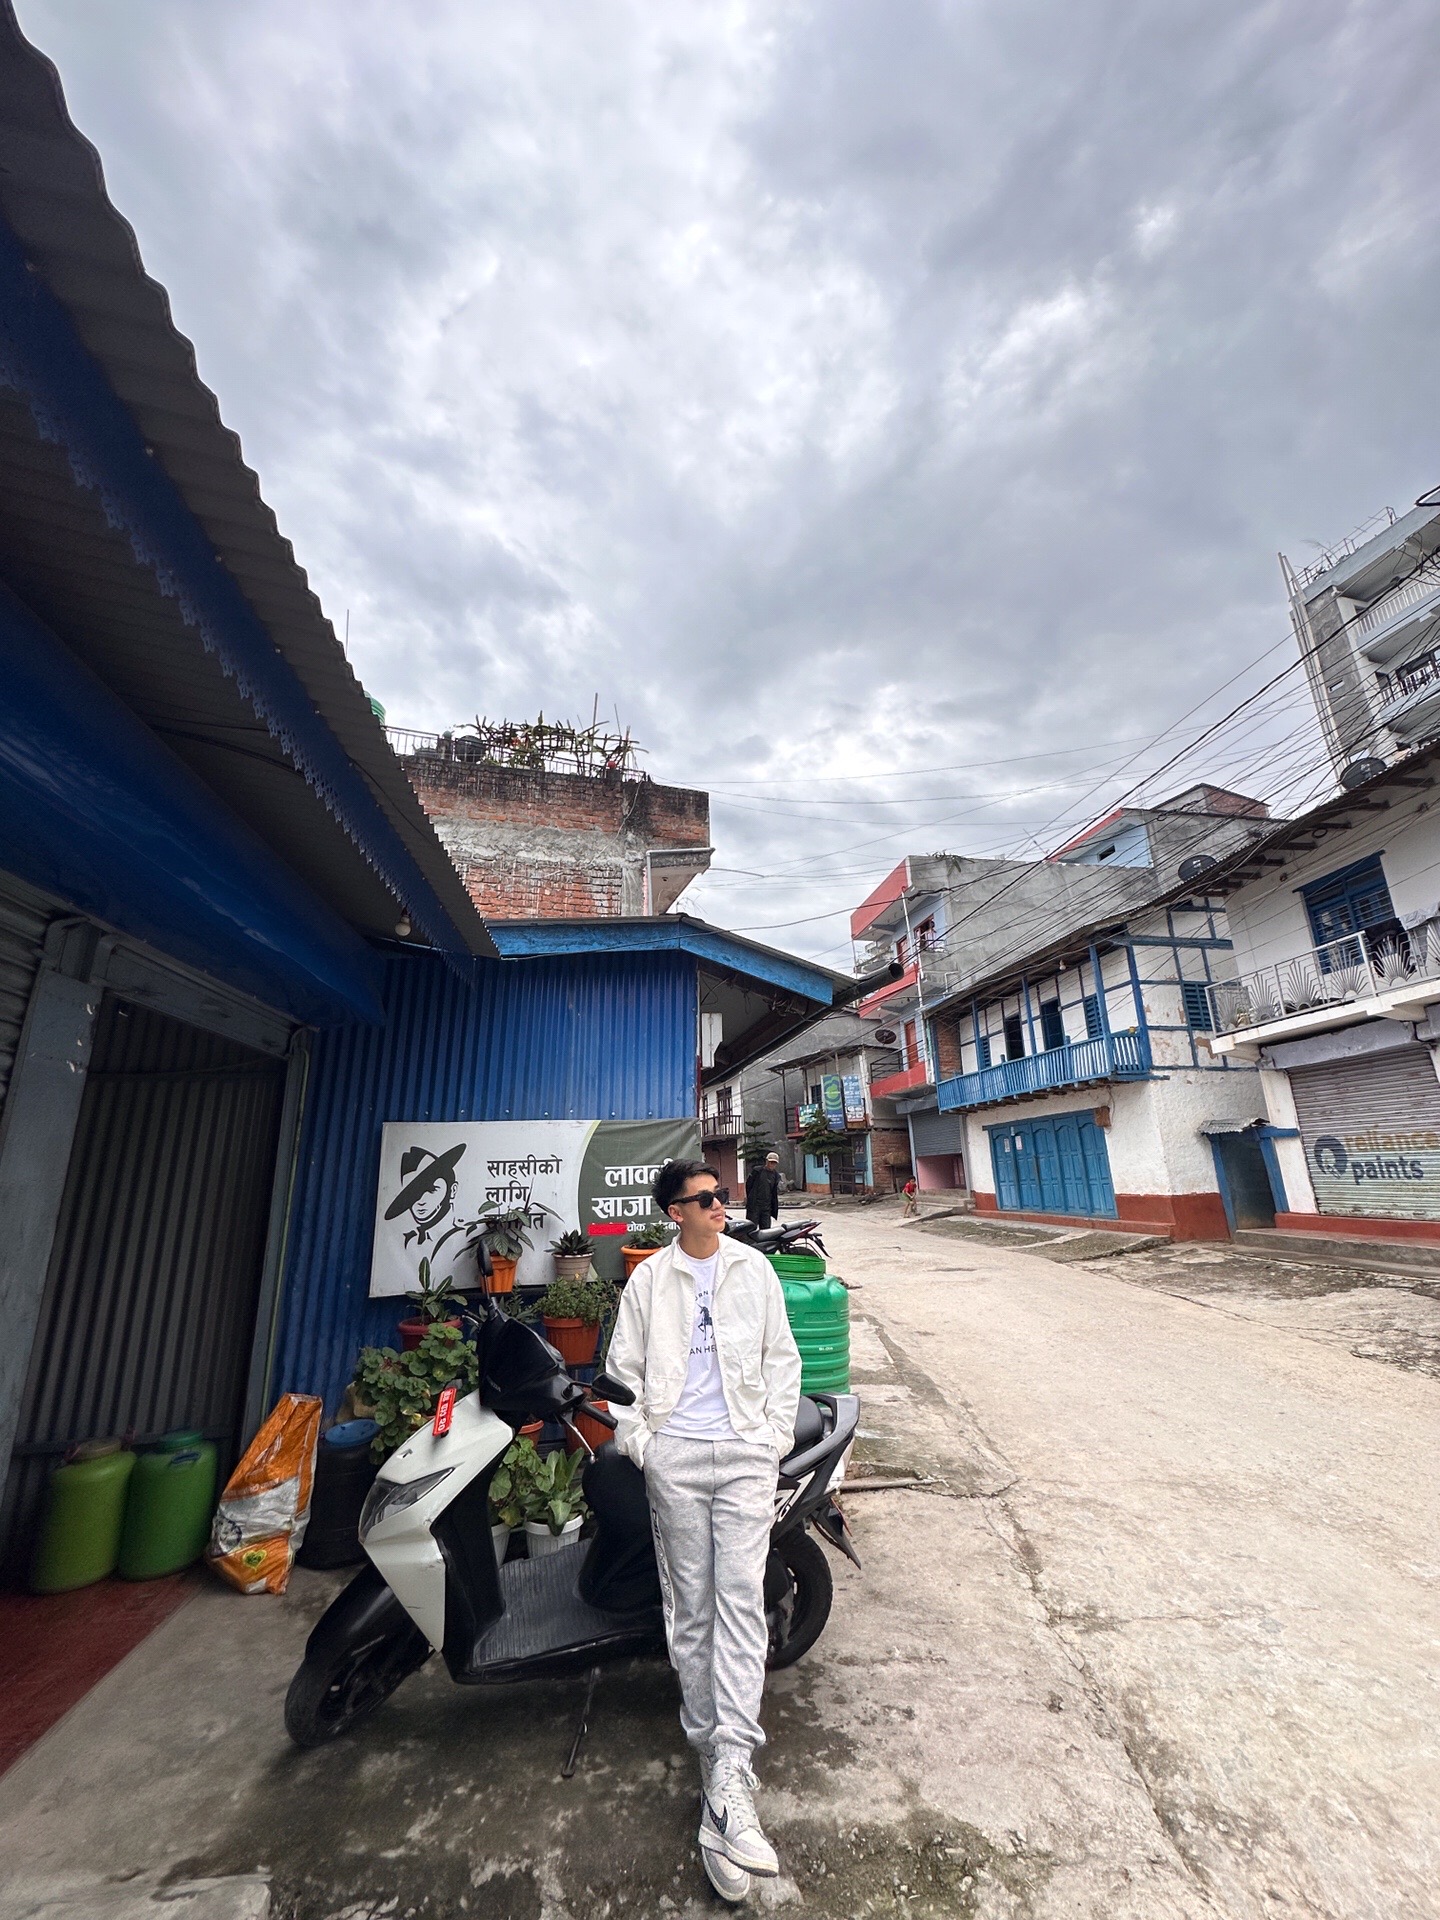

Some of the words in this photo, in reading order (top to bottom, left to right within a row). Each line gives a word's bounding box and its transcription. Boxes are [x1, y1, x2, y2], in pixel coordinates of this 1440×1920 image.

[1344, 1124, 1440, 1153] reliance
[487, 1154, 563, 1179] साहसीको
[1351, 1155, 1424, 1185] paints
[485, 1180, 530, 1203] लागि
[591, 1195, 653, 1219] खाजा
